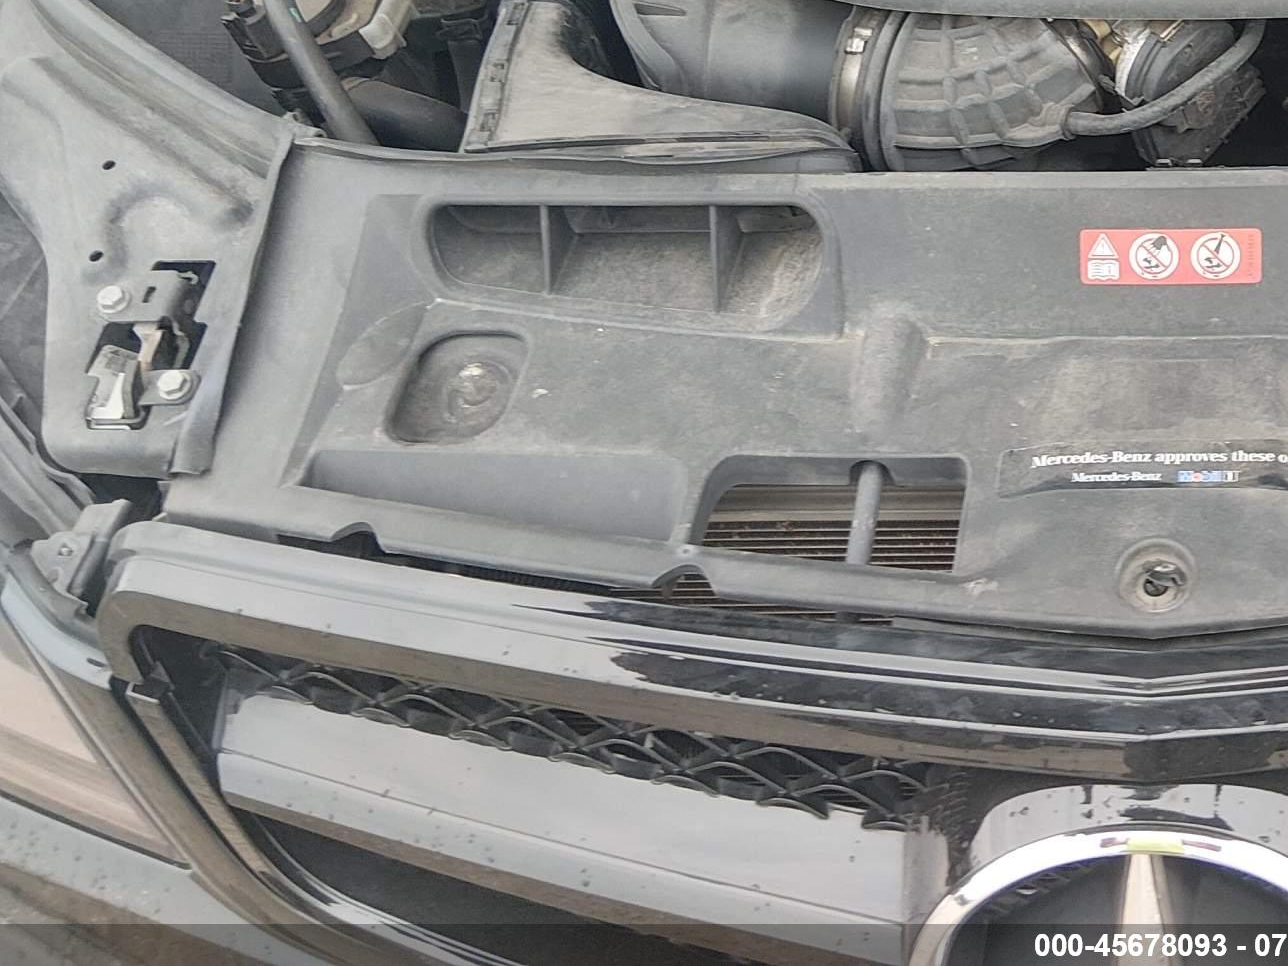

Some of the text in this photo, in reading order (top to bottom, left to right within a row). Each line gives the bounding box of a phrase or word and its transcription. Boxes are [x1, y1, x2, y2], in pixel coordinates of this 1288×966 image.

[1030, 450, 1152, 469] Mercedes-Benz
[1154, 452, 1228, 465] approves
[1231, 449, 1276, 462] these
